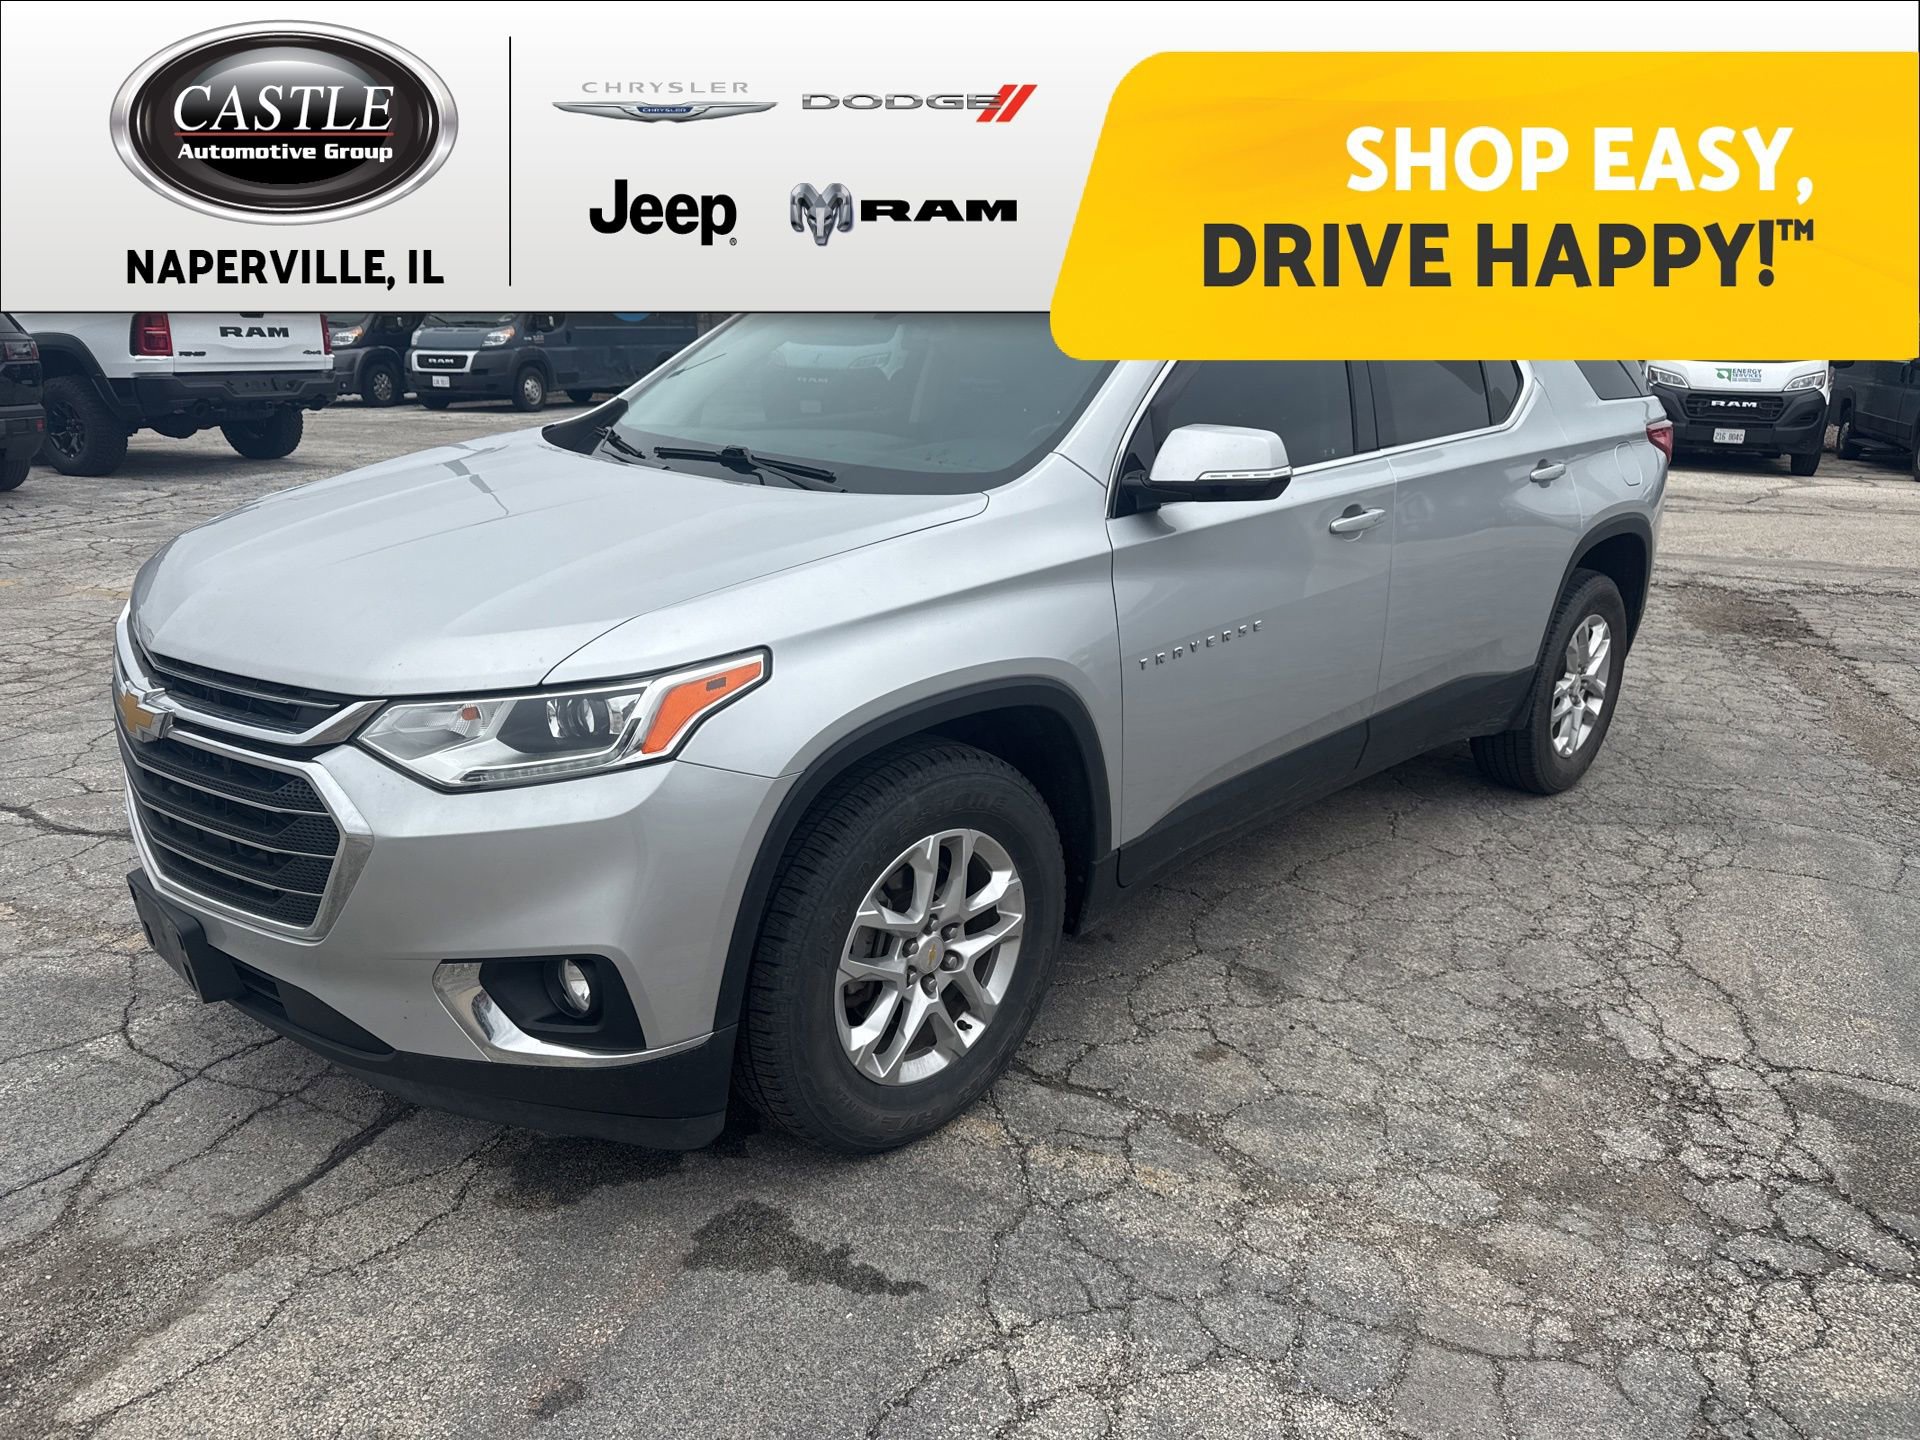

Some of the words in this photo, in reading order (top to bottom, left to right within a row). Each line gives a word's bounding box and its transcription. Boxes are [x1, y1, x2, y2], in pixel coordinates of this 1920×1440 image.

[219, 326, 290, 338] RAM
[1711, 400, 1757, 408] RAM
[1138, 619, 1264, 671] TRAVERSE
